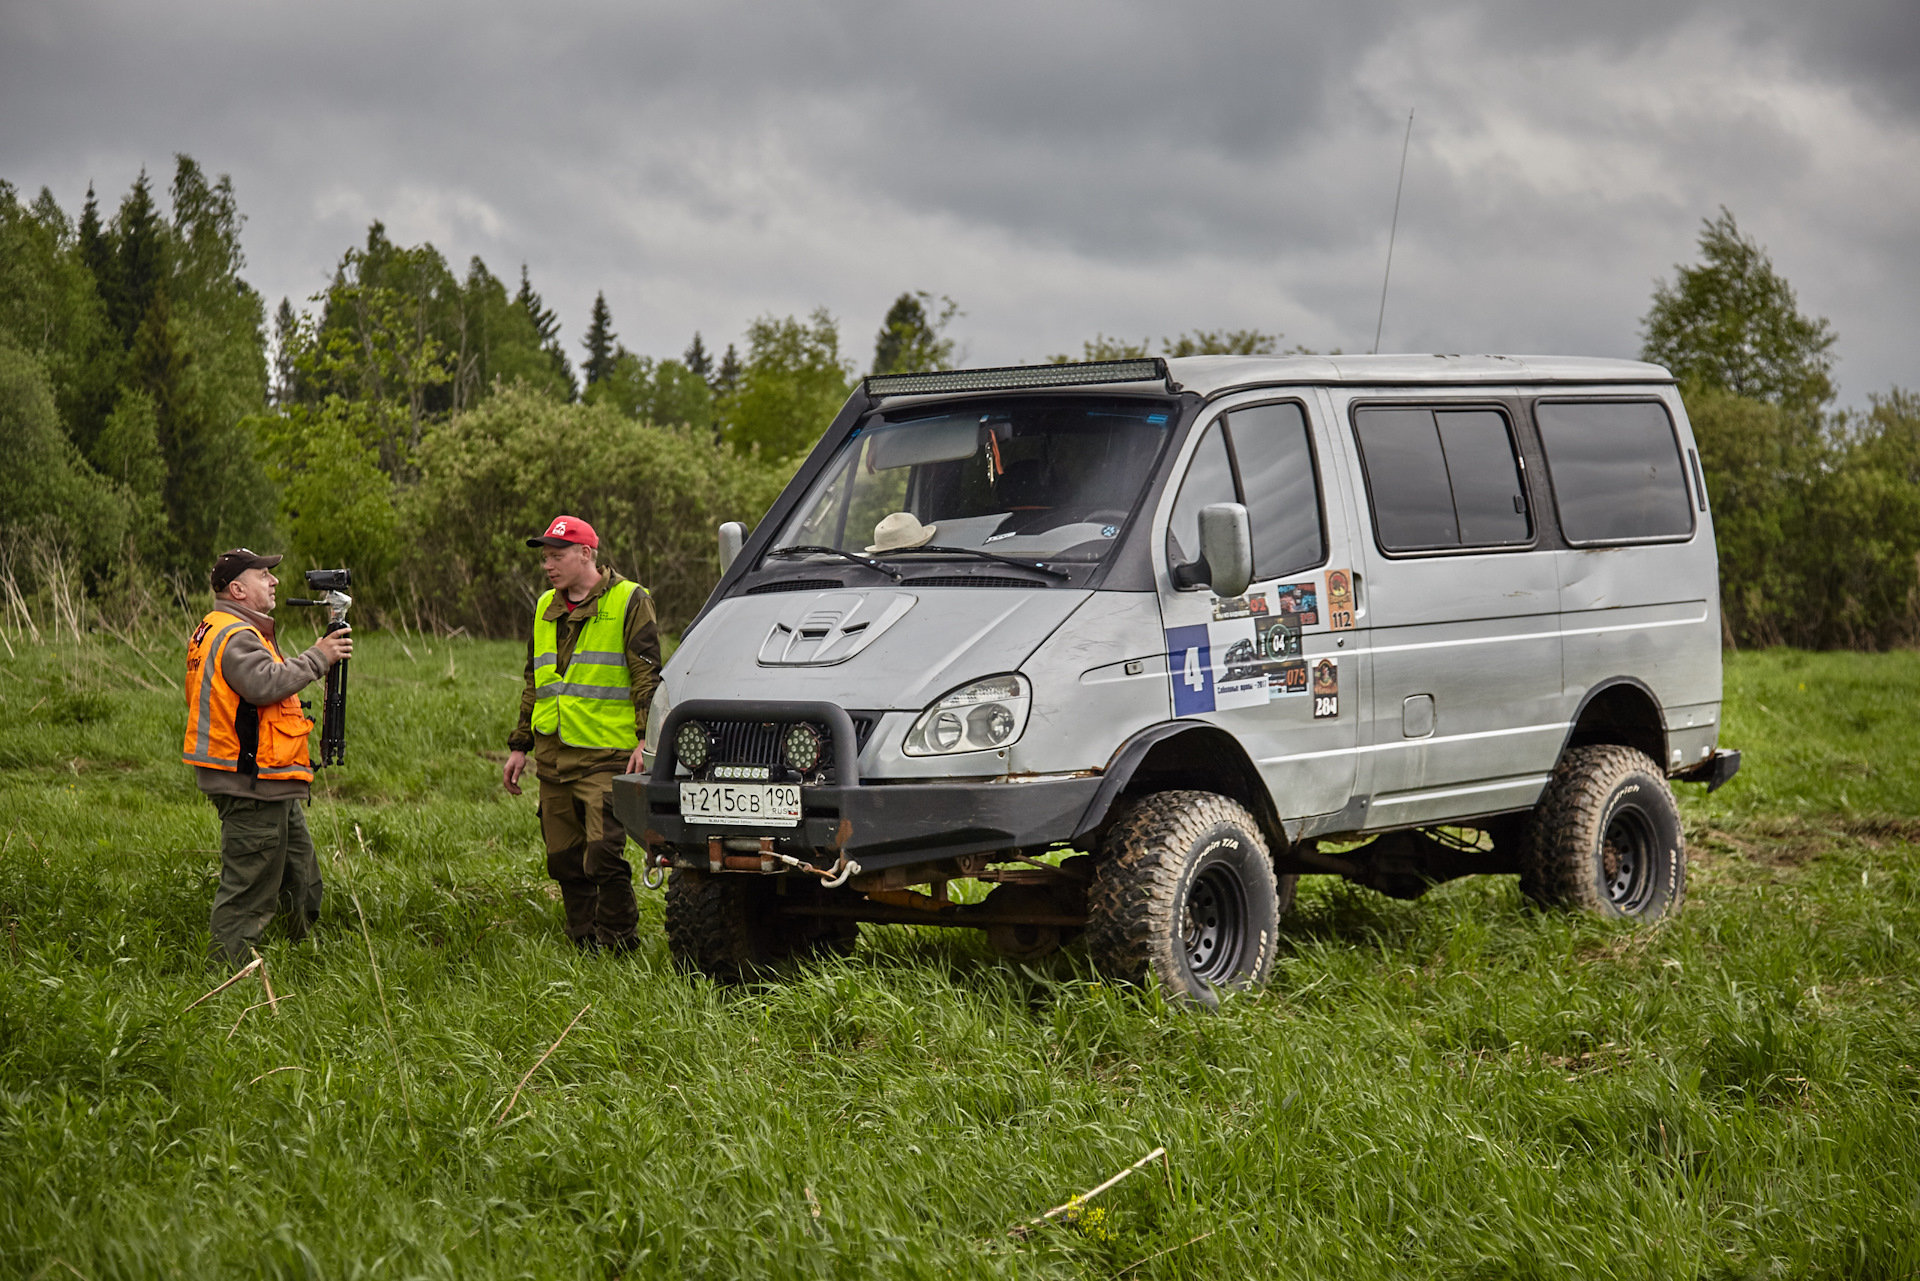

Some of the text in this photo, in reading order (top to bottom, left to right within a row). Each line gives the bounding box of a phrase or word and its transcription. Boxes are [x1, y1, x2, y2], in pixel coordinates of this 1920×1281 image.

[1250, 598, 1267, 612] 02
[1332, 611, 1352, 628] 112
[1272, 634, 1285, 652] 04
[1184, 647, 1204, 692] 4
[1287, 668, 1306, 686] 075
[1315, 696, 1337, 716] 284
[766, 788, 795, 806] 190
[1221, 837, 1239, 850] T/A
